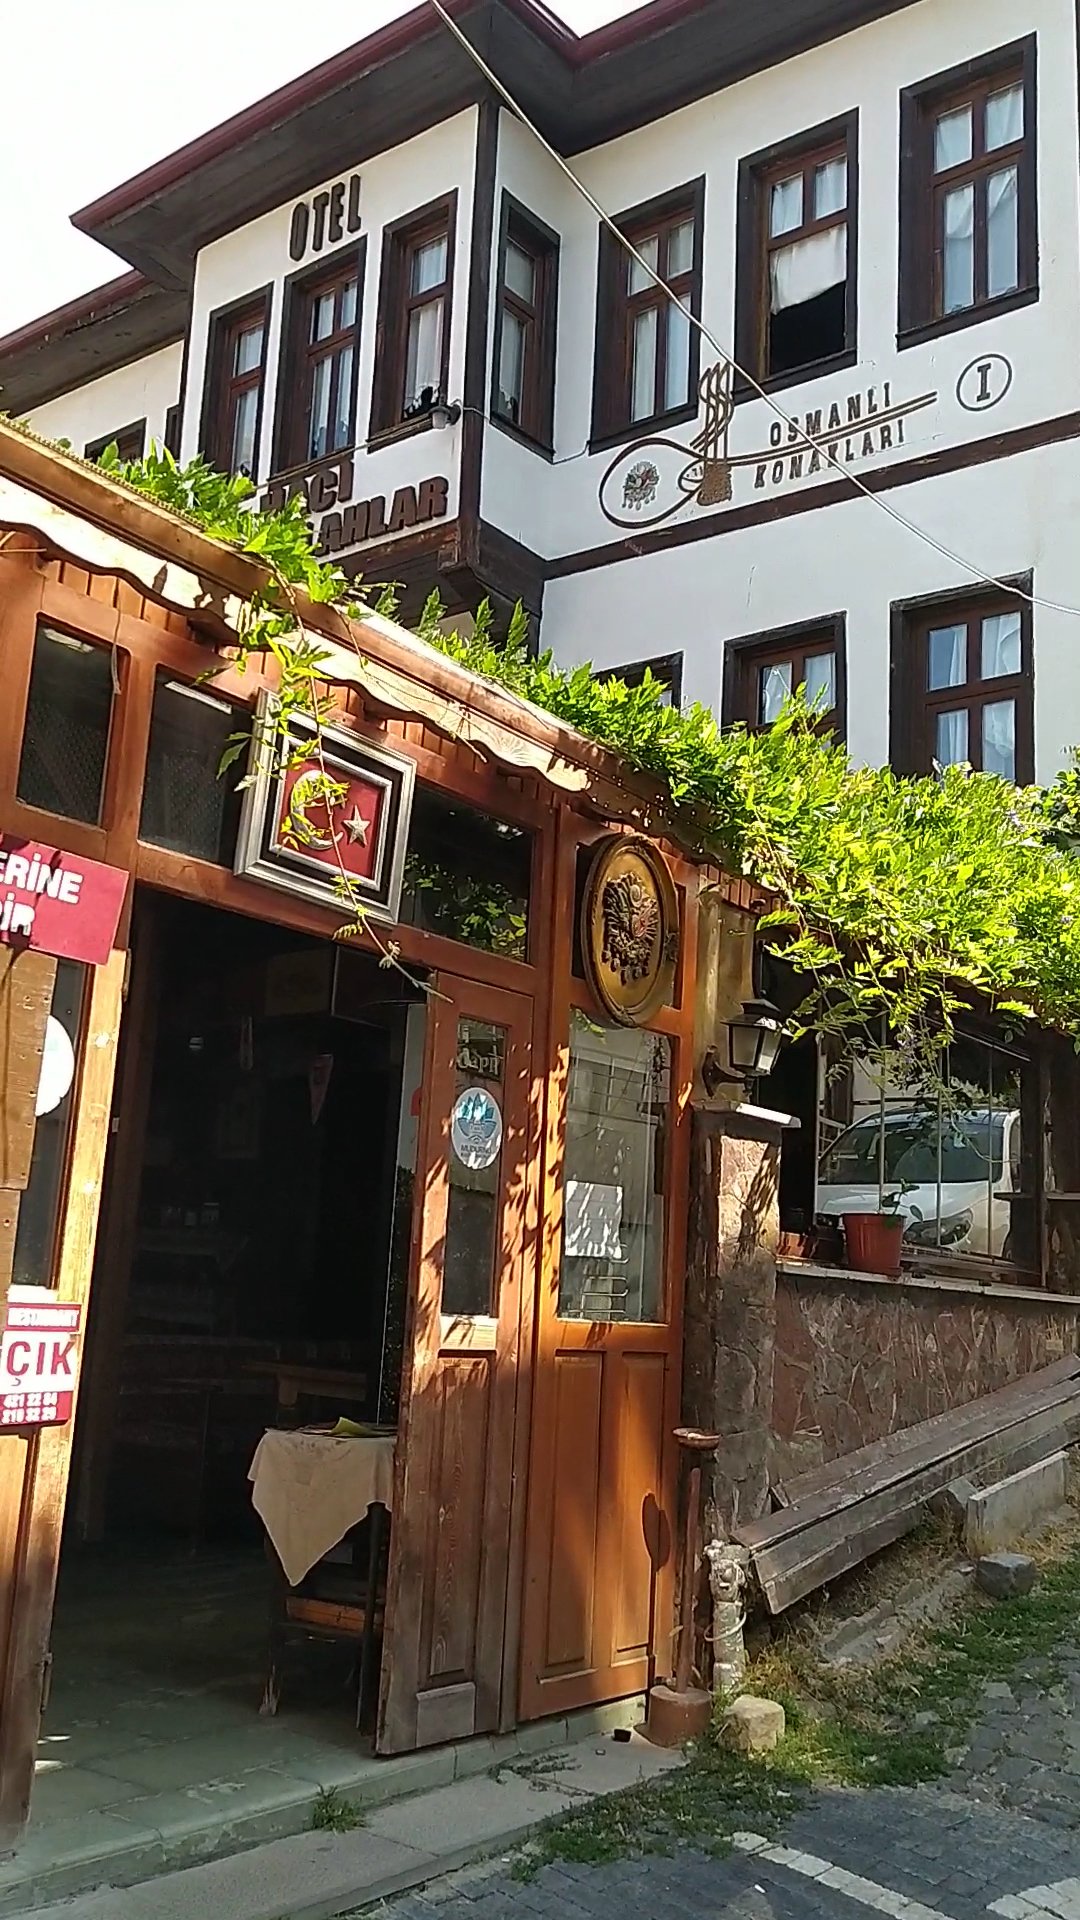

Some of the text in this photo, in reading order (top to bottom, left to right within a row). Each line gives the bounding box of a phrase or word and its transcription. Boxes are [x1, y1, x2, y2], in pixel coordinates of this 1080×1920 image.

[290, 174, 361, 262] OTEL
[770, 382, 891, 447] OSMANLI
[754, 419, 905, 488] KONAKLARI
[0, 1341, 75, 1387] ÇIK
